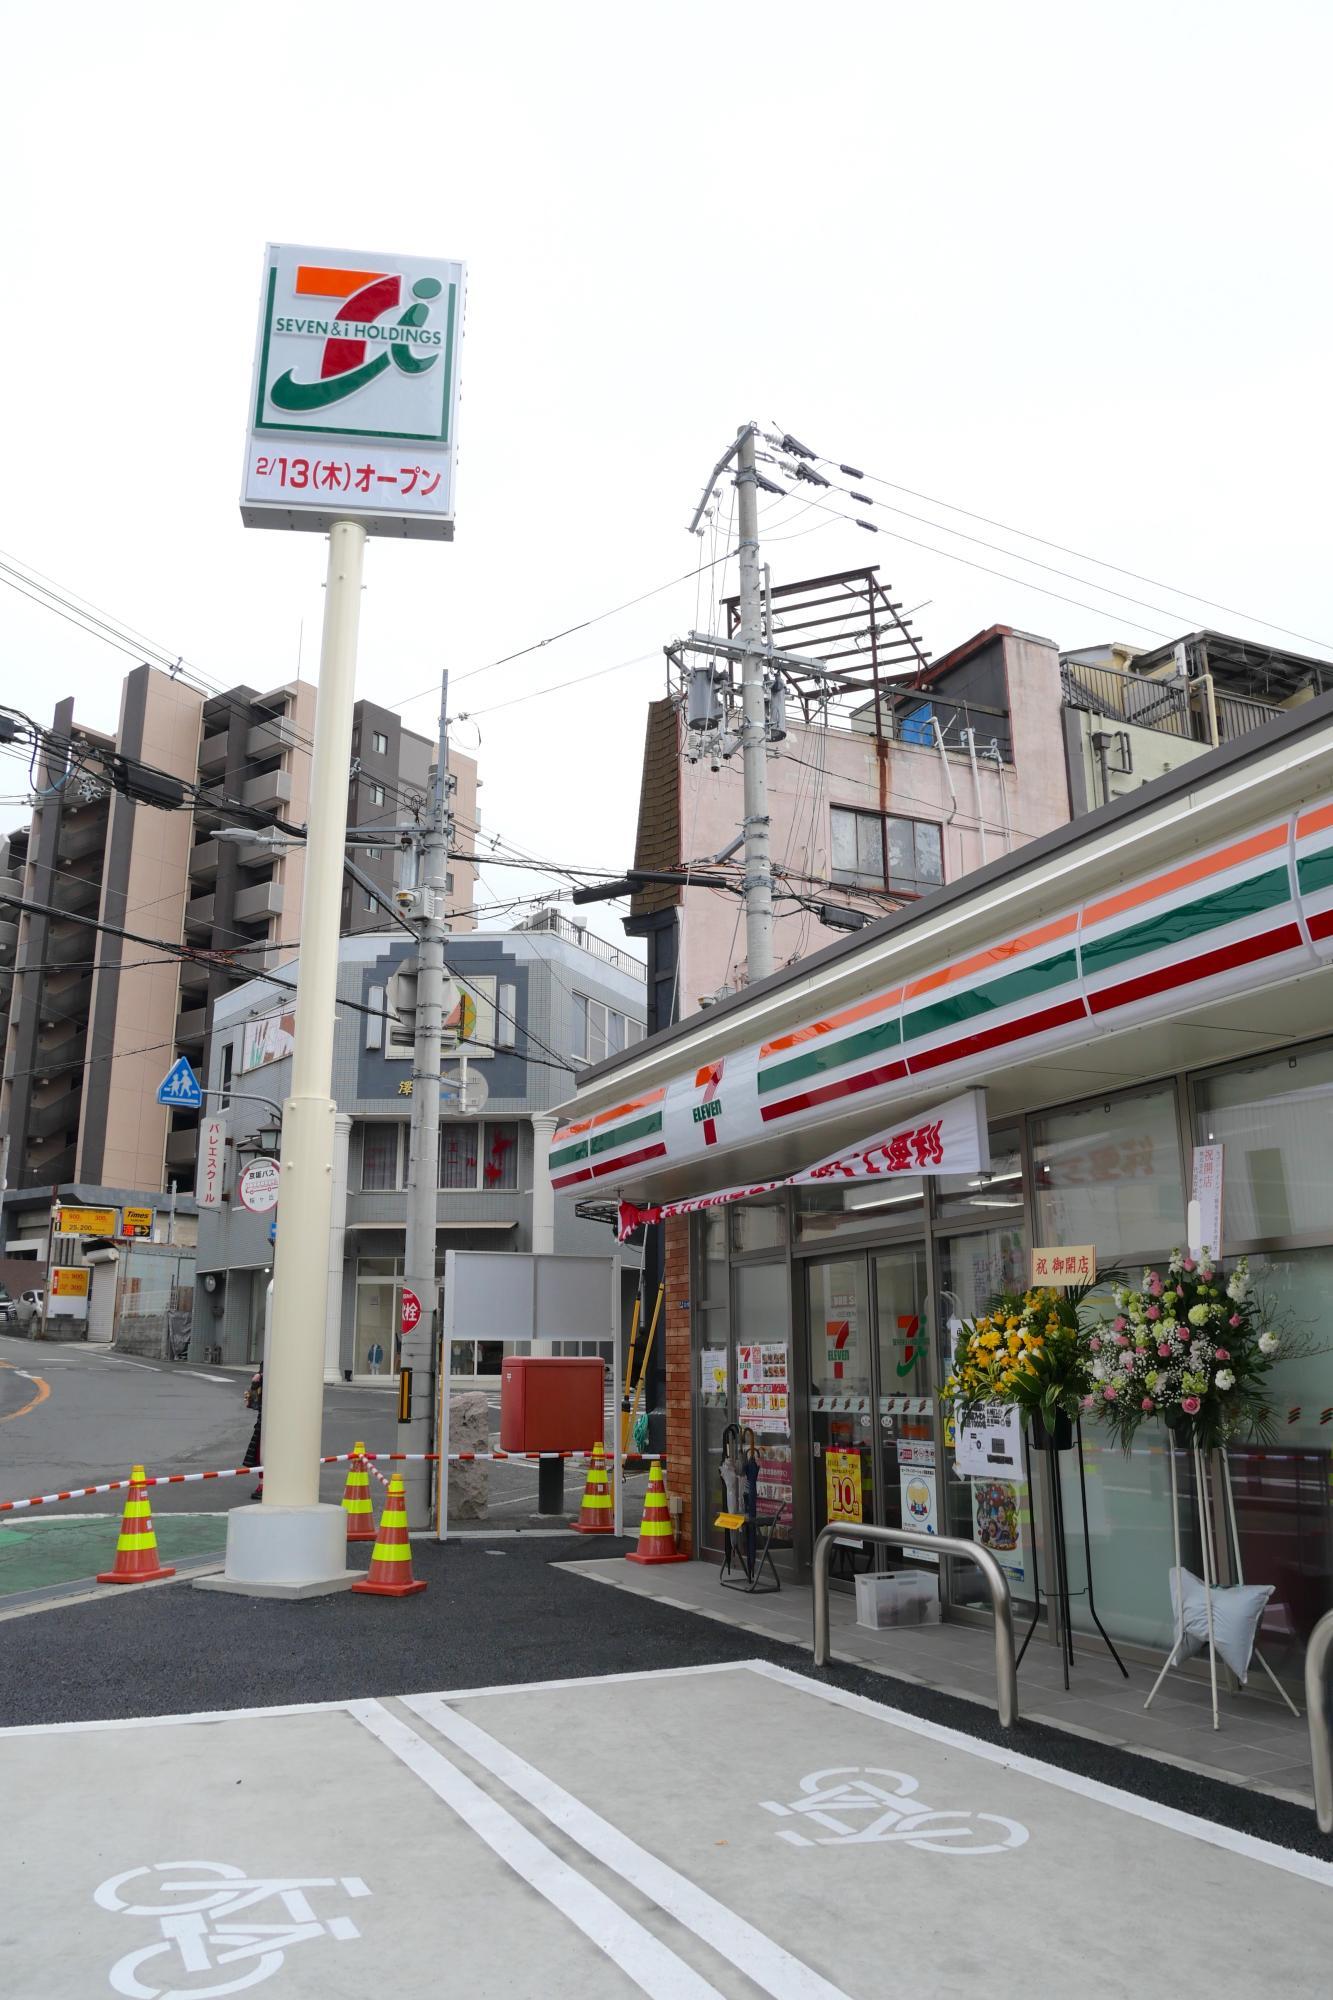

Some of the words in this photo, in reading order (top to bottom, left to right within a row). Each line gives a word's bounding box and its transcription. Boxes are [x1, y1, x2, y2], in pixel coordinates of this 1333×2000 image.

[355, 325, 441, 345] HOLDINGS
[204, 1123, 219, 1203] バレエスクール
[126, 1210, 149, 1219] Times
[1036, 1257, 1048, 1276] 祝
[1052, 1256, 1089, 1276] 御開店
